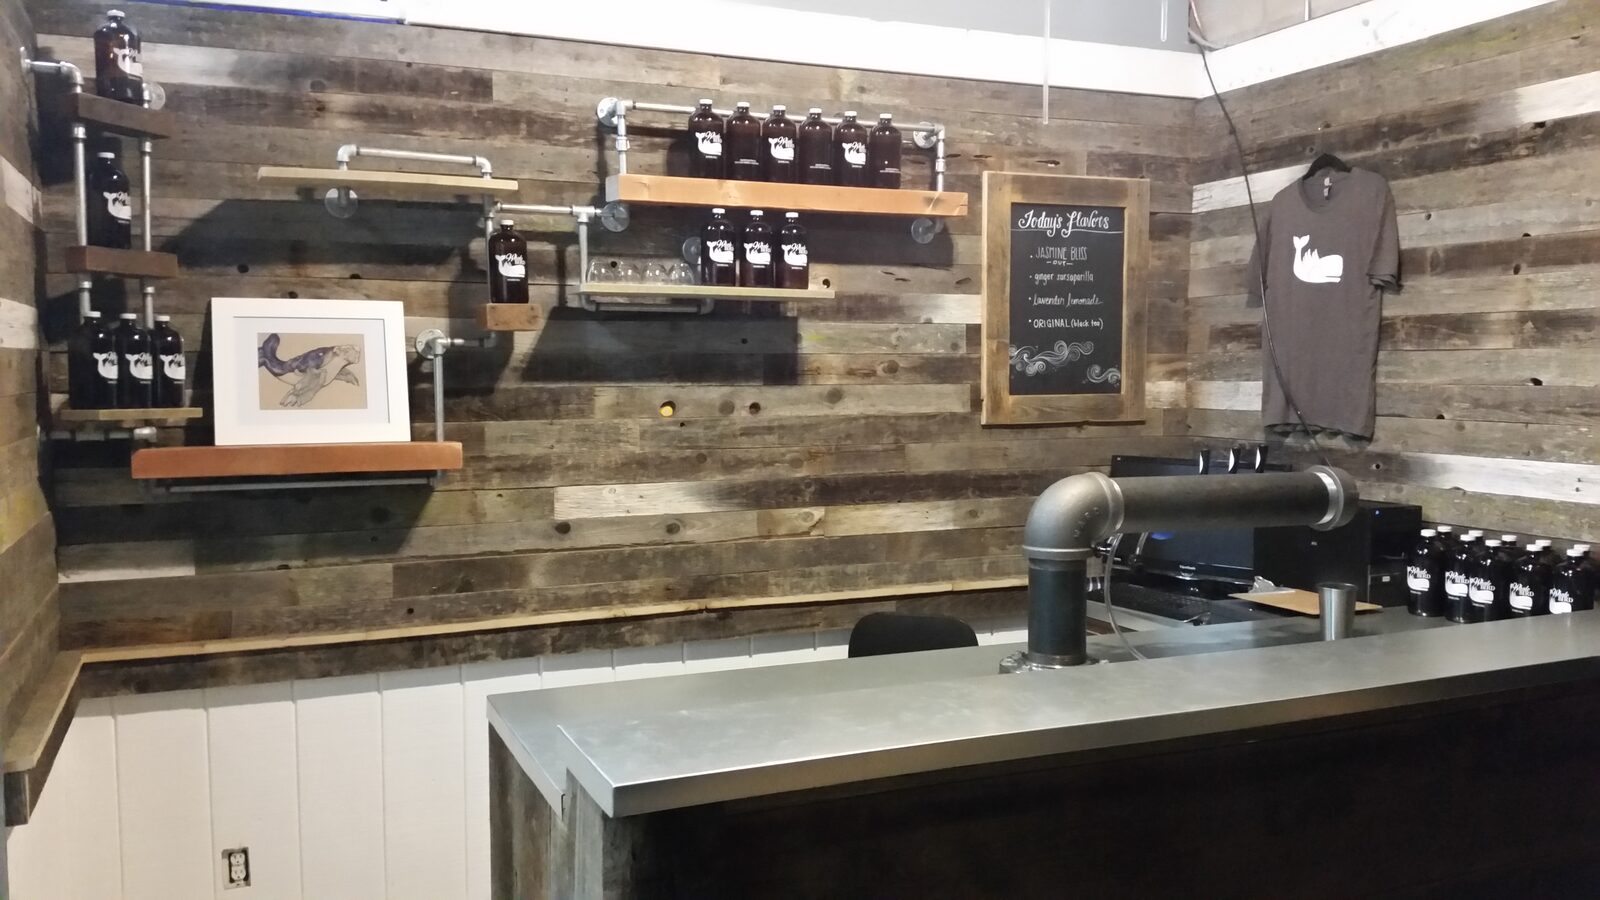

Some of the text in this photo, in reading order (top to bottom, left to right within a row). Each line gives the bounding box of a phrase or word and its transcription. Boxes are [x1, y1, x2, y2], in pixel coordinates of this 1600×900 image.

[1018, 209, 1110, 238] Today's Flavors
[1035, 246, 1088, 260] JASMINE BLISS
[1034, 273, 1054, 285] ginger
